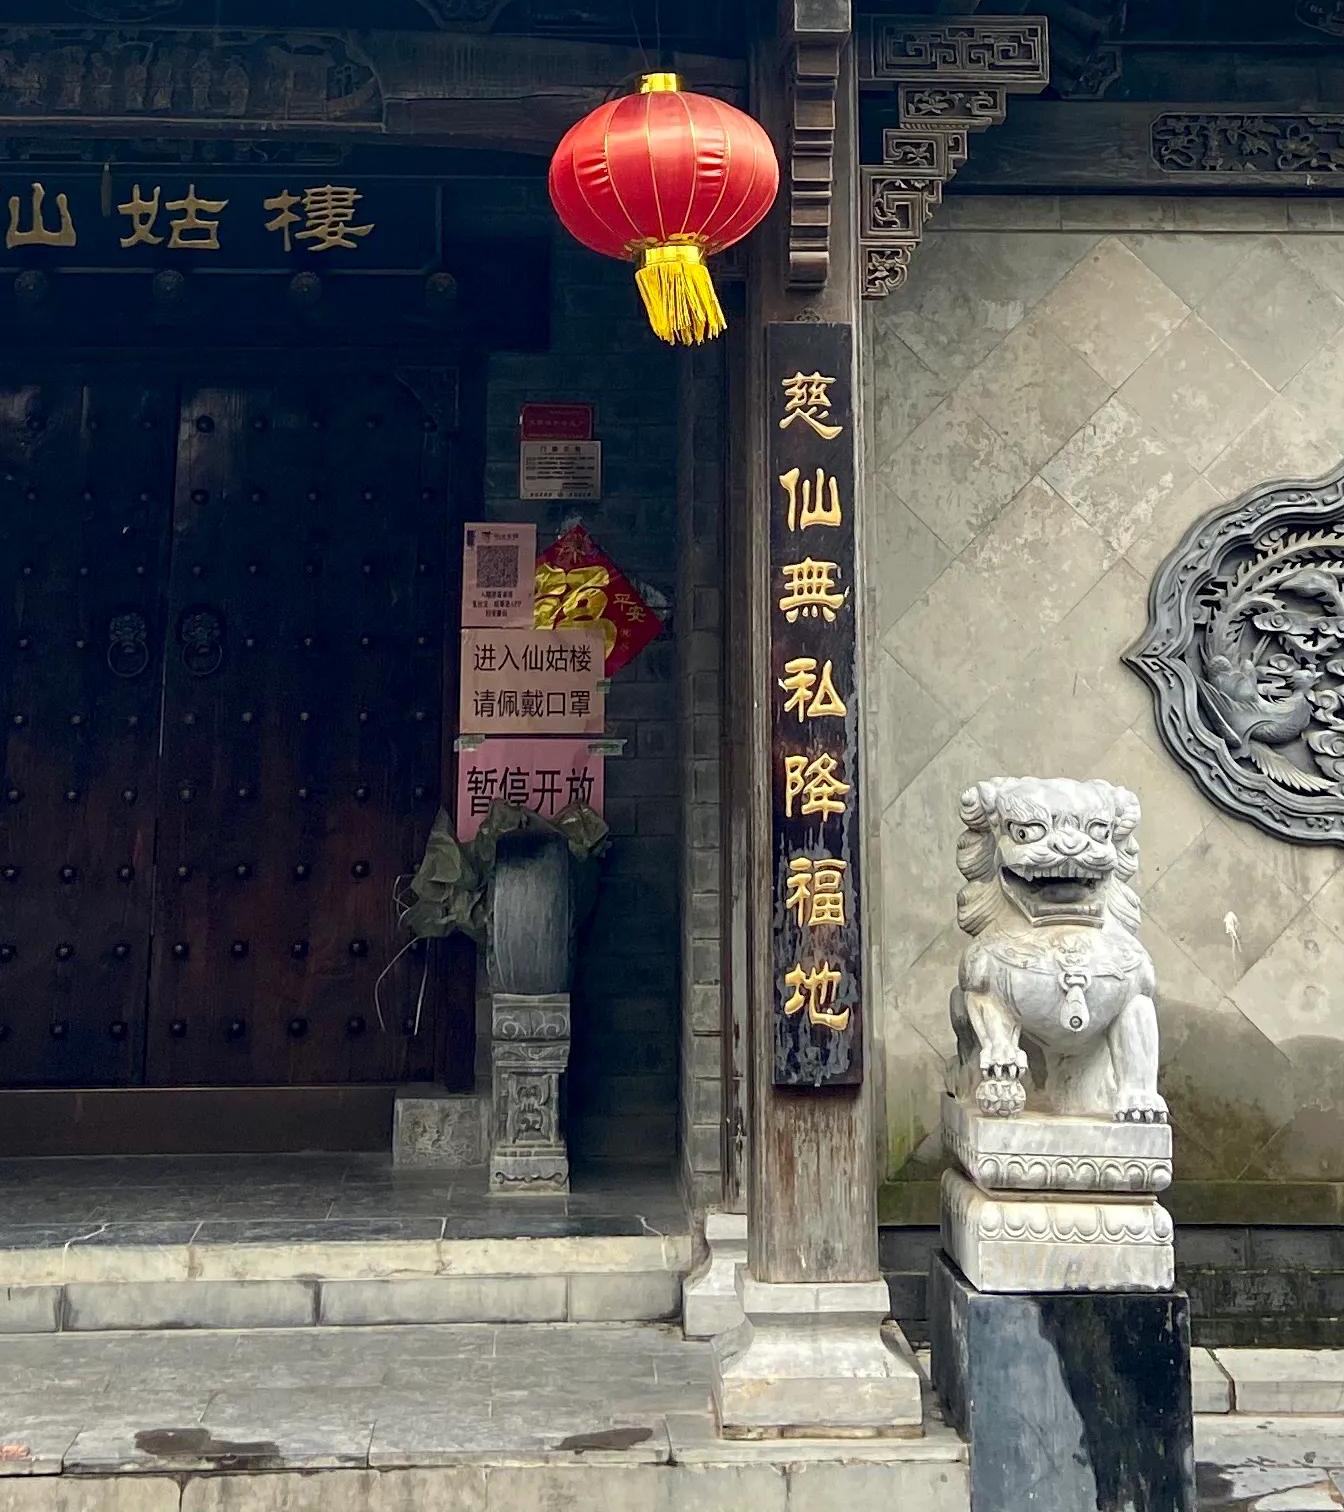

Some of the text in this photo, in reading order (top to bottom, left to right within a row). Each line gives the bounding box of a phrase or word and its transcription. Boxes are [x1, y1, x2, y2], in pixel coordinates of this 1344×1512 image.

[613, 593, 646, 623] 平安
[473, 642, 592, 674] 进入仙姑楼
[473, 688, 591, 718] 请佩戴口罩
[466, 765, 596, 817] 暂停开放
